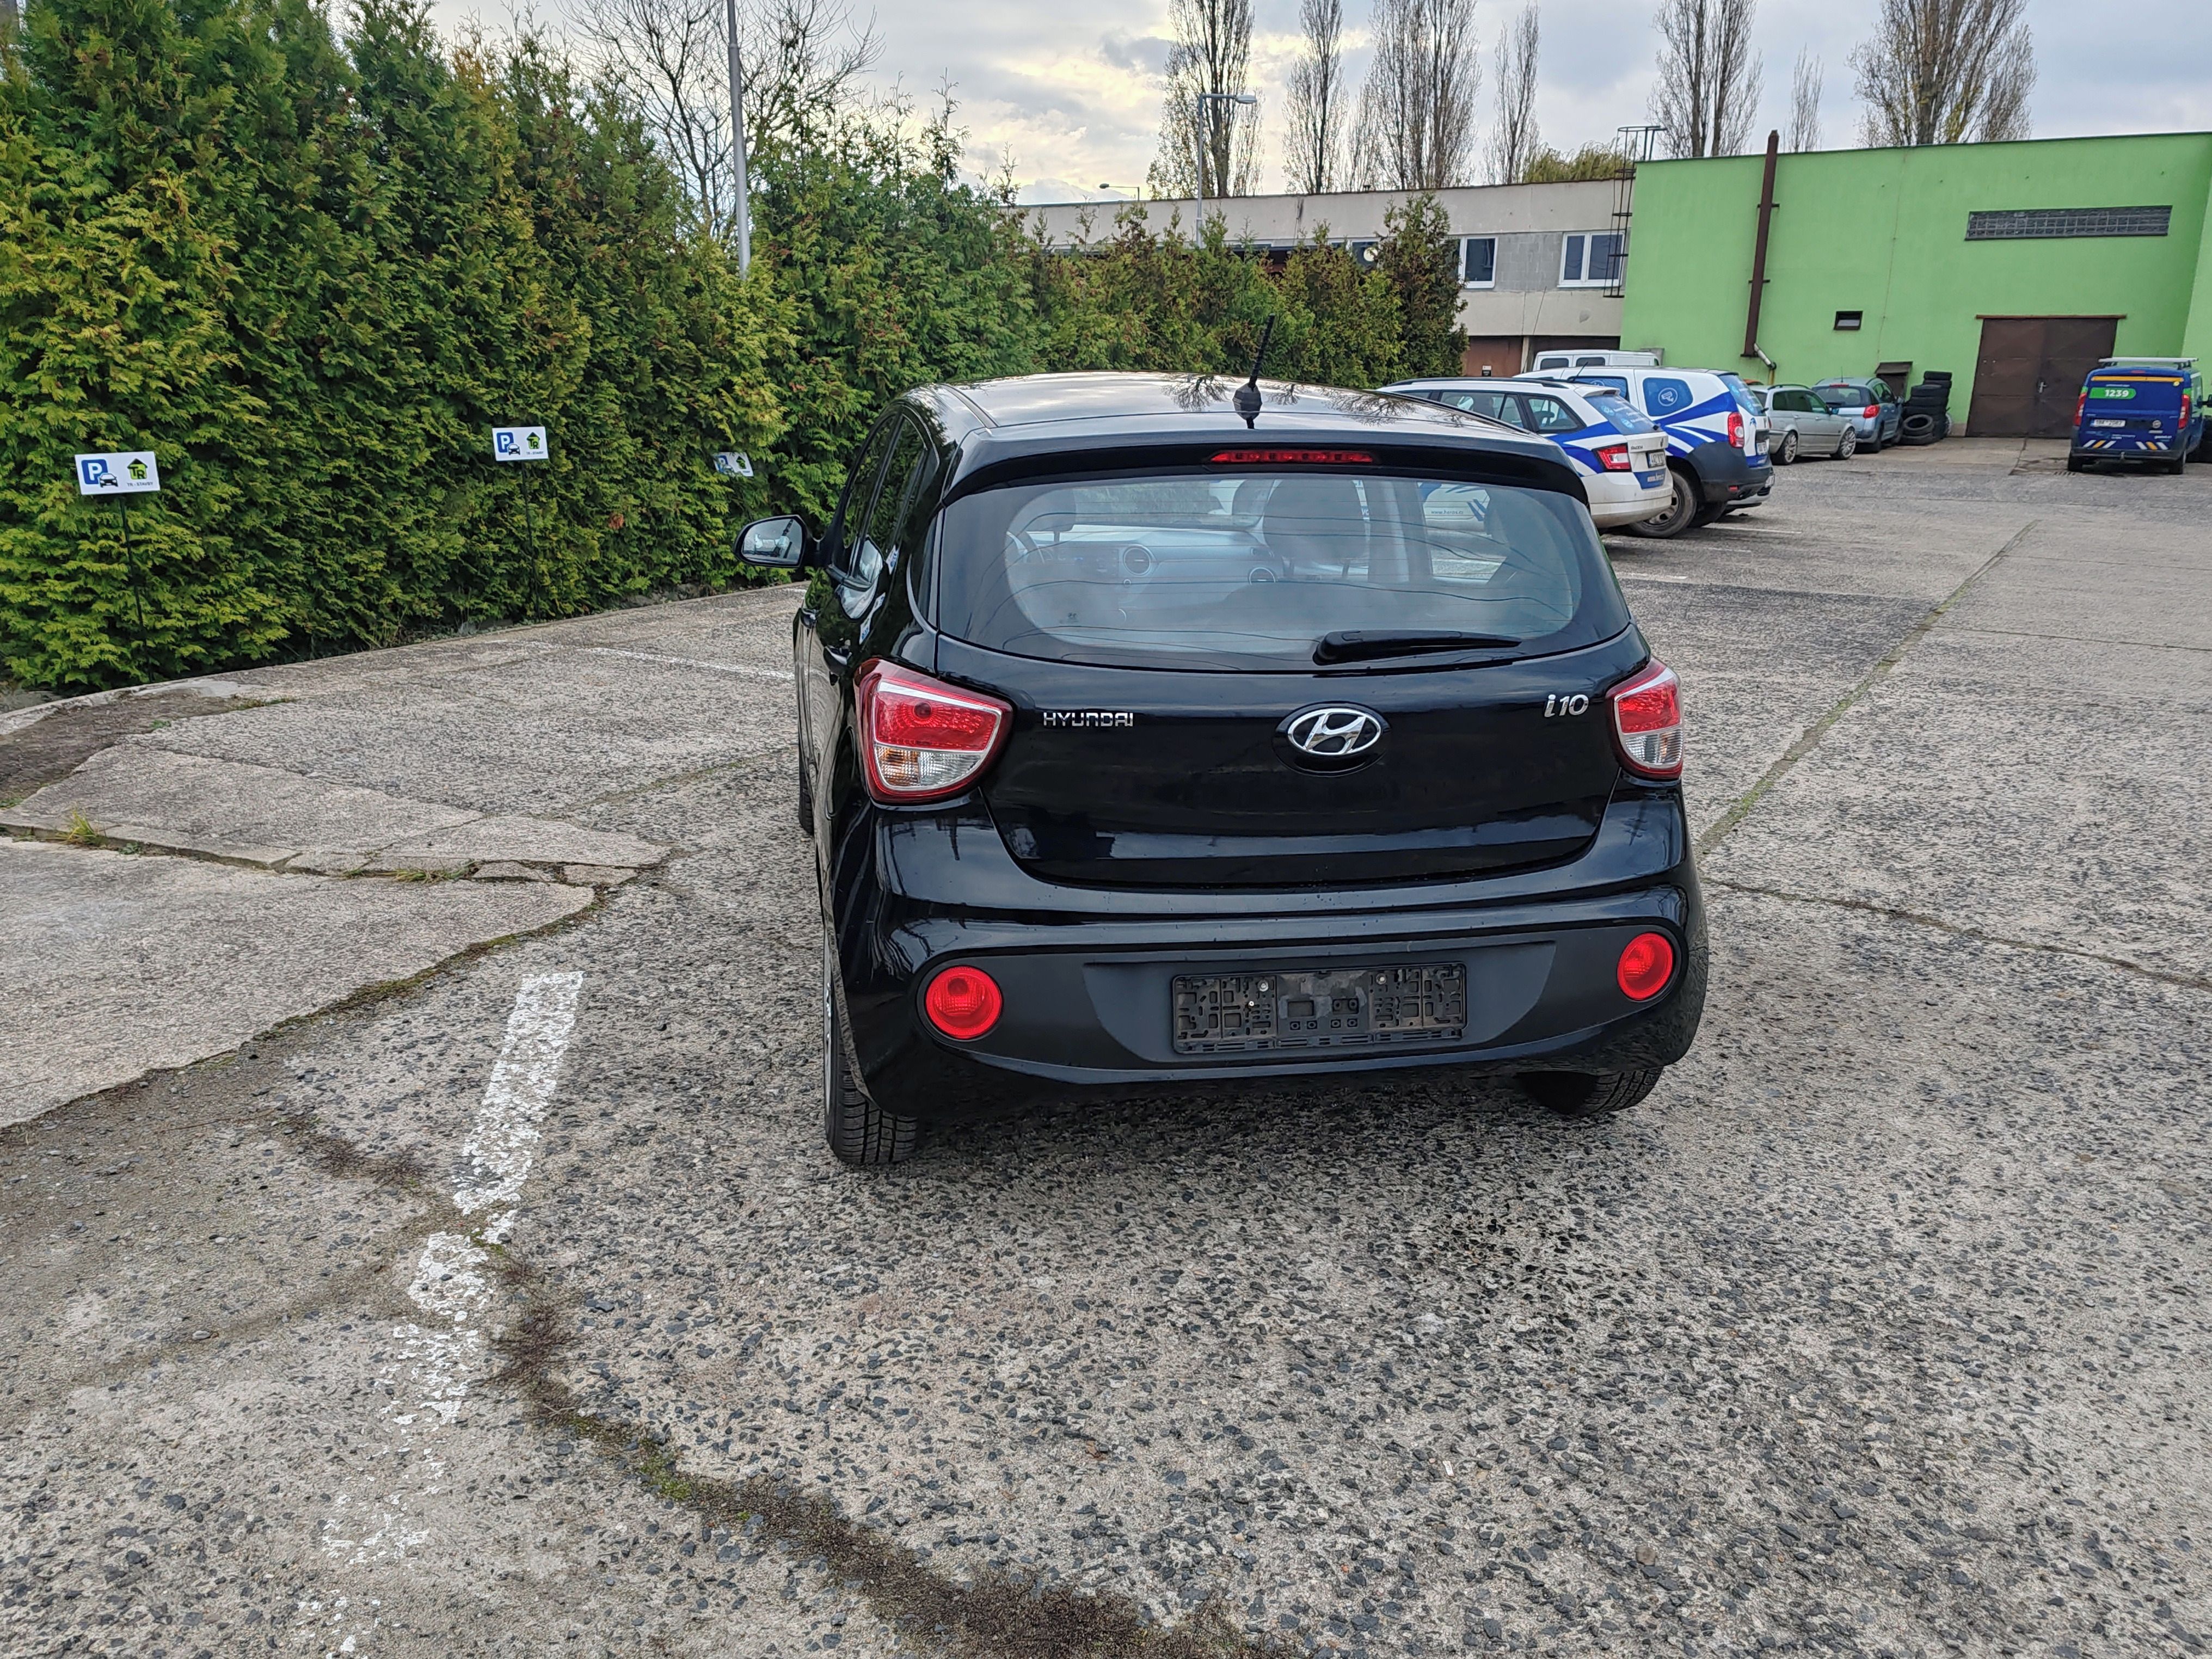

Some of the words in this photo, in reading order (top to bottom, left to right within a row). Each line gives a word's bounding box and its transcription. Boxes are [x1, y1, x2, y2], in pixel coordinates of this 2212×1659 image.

[2105, 389, 2129, 397] 1239
[500, 435, 511, 450] P
[88, 462, 102, 481] P
[130, 466, 145, 479] TR
[1544, 694, 1589, 717] i10
[1043, 712, 1133, 727] HYUNDAI
